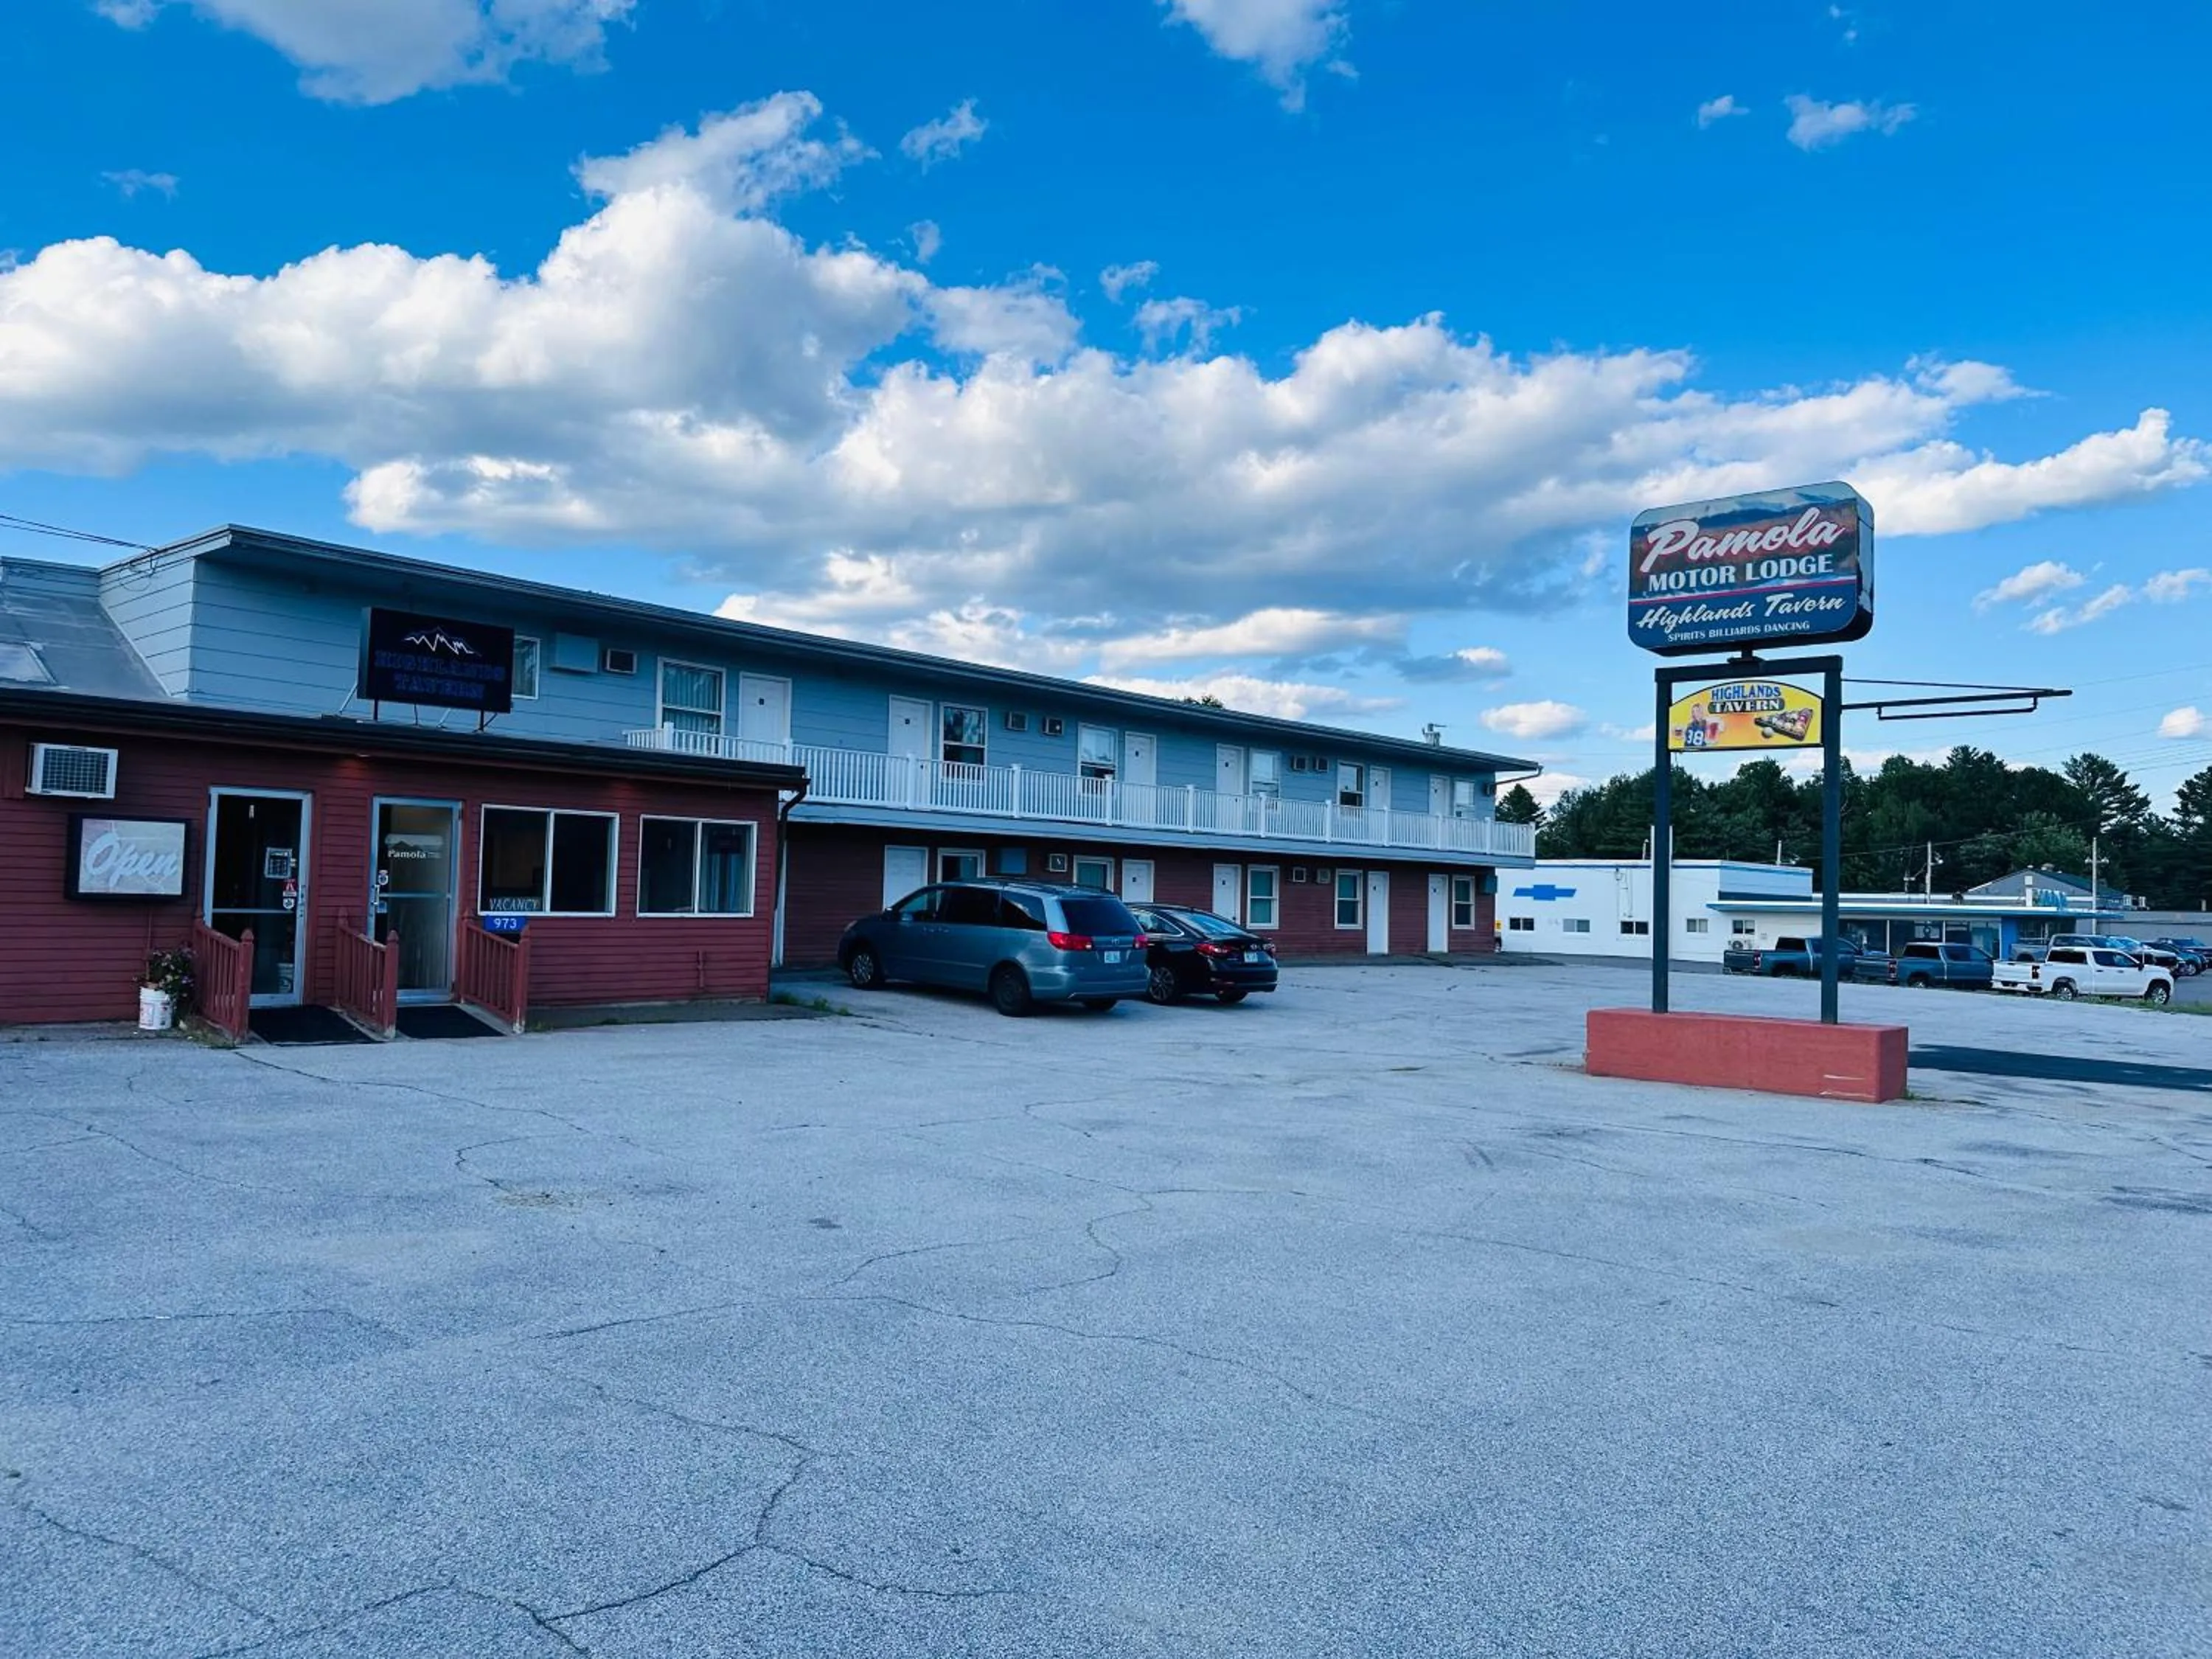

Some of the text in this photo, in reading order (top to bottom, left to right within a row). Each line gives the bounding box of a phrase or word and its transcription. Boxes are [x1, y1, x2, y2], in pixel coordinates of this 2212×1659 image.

[1640, 507, 1846, 572] Pamola
[1648, 554, 1834, 592] MOTOR LODGE
[1636, 593, 1846, 633] Highlands Tavern
[1667, 621, 1811, 642] SPIRITS BILLIARDS DANCING
[1711, 684, 1781, 700] HIGHLANDS
[1713, 699, 1780, 713] TAVERN
[86, 832, 178, 888] Open
[388, 849, 426, 859] Pamola
[493, 918, 517, 929] 973
